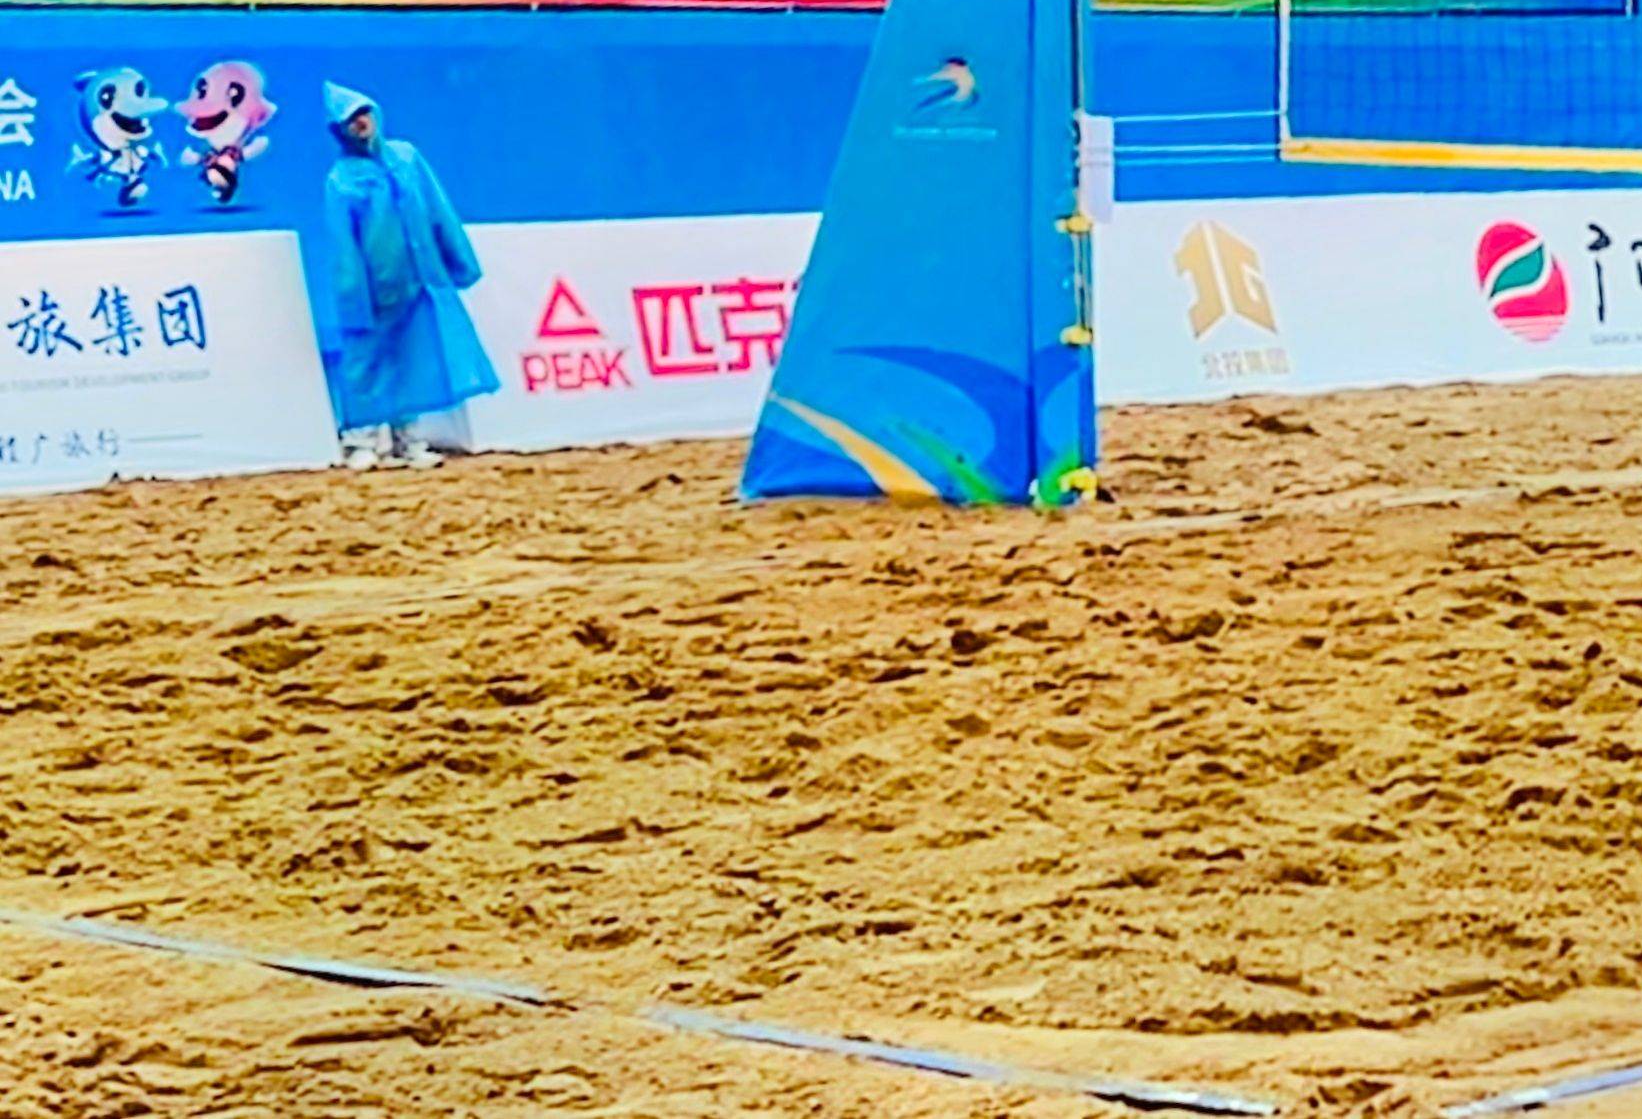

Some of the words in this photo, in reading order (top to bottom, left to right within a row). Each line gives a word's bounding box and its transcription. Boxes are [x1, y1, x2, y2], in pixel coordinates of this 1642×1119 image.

[7, 284, 208, 357] 旅集团
[520, 348, 633, 392] PEAK
